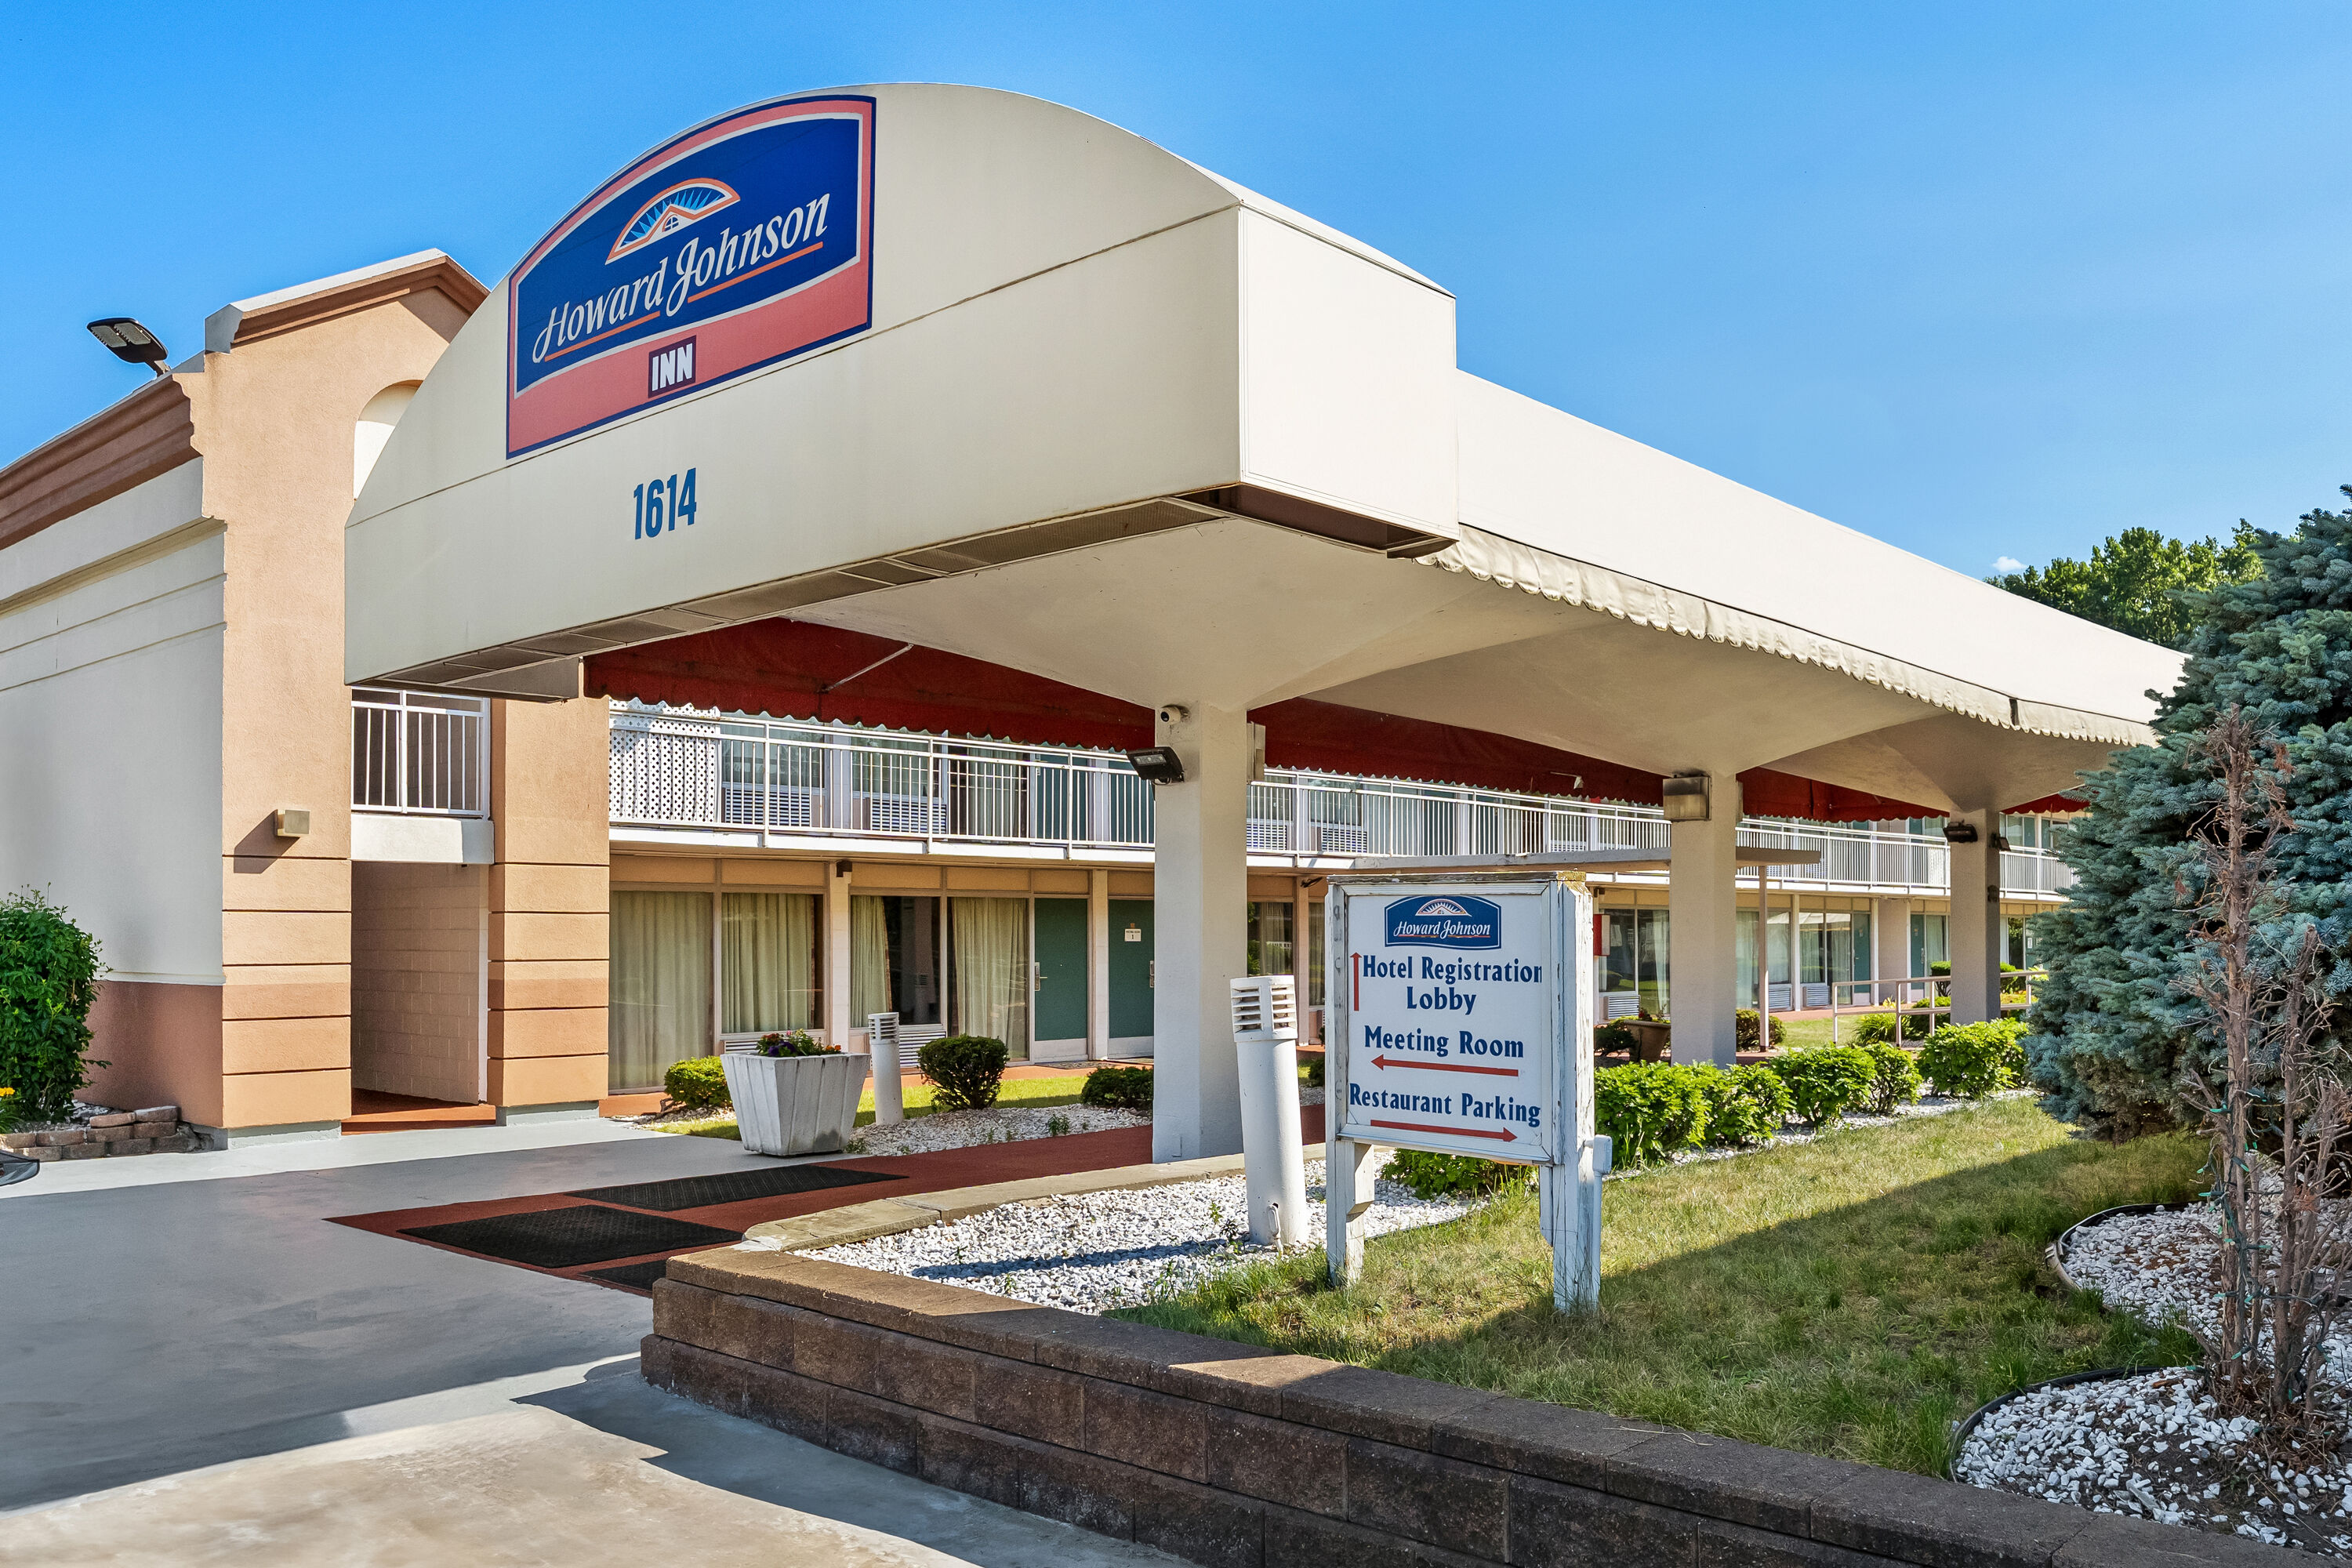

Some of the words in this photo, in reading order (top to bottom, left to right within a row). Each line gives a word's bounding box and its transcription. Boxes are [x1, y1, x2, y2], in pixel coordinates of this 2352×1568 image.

[533, 257, 668, 363] Howard
[666, 193, 829, 317] Johnson
[652, 343, 693, 391] INN
[633, 468, 697, 540] 1614
[1393, 921, 1441, 937] Howard
[1439, 920, 1490, 939] Johnson
[1363, 955, 1413, 979] Hotel
[1421, 956, 1543, 985] Registration
[1406, 985, 1476, 1015] Lobby
[1364, 1025, 1449, 1058] Meeting
[1459, 1031, 1524, 1058] Room
[1349, 1083, 1452, 1115] Restaurant
[1461, 1092, 1541, 1128] Parking
